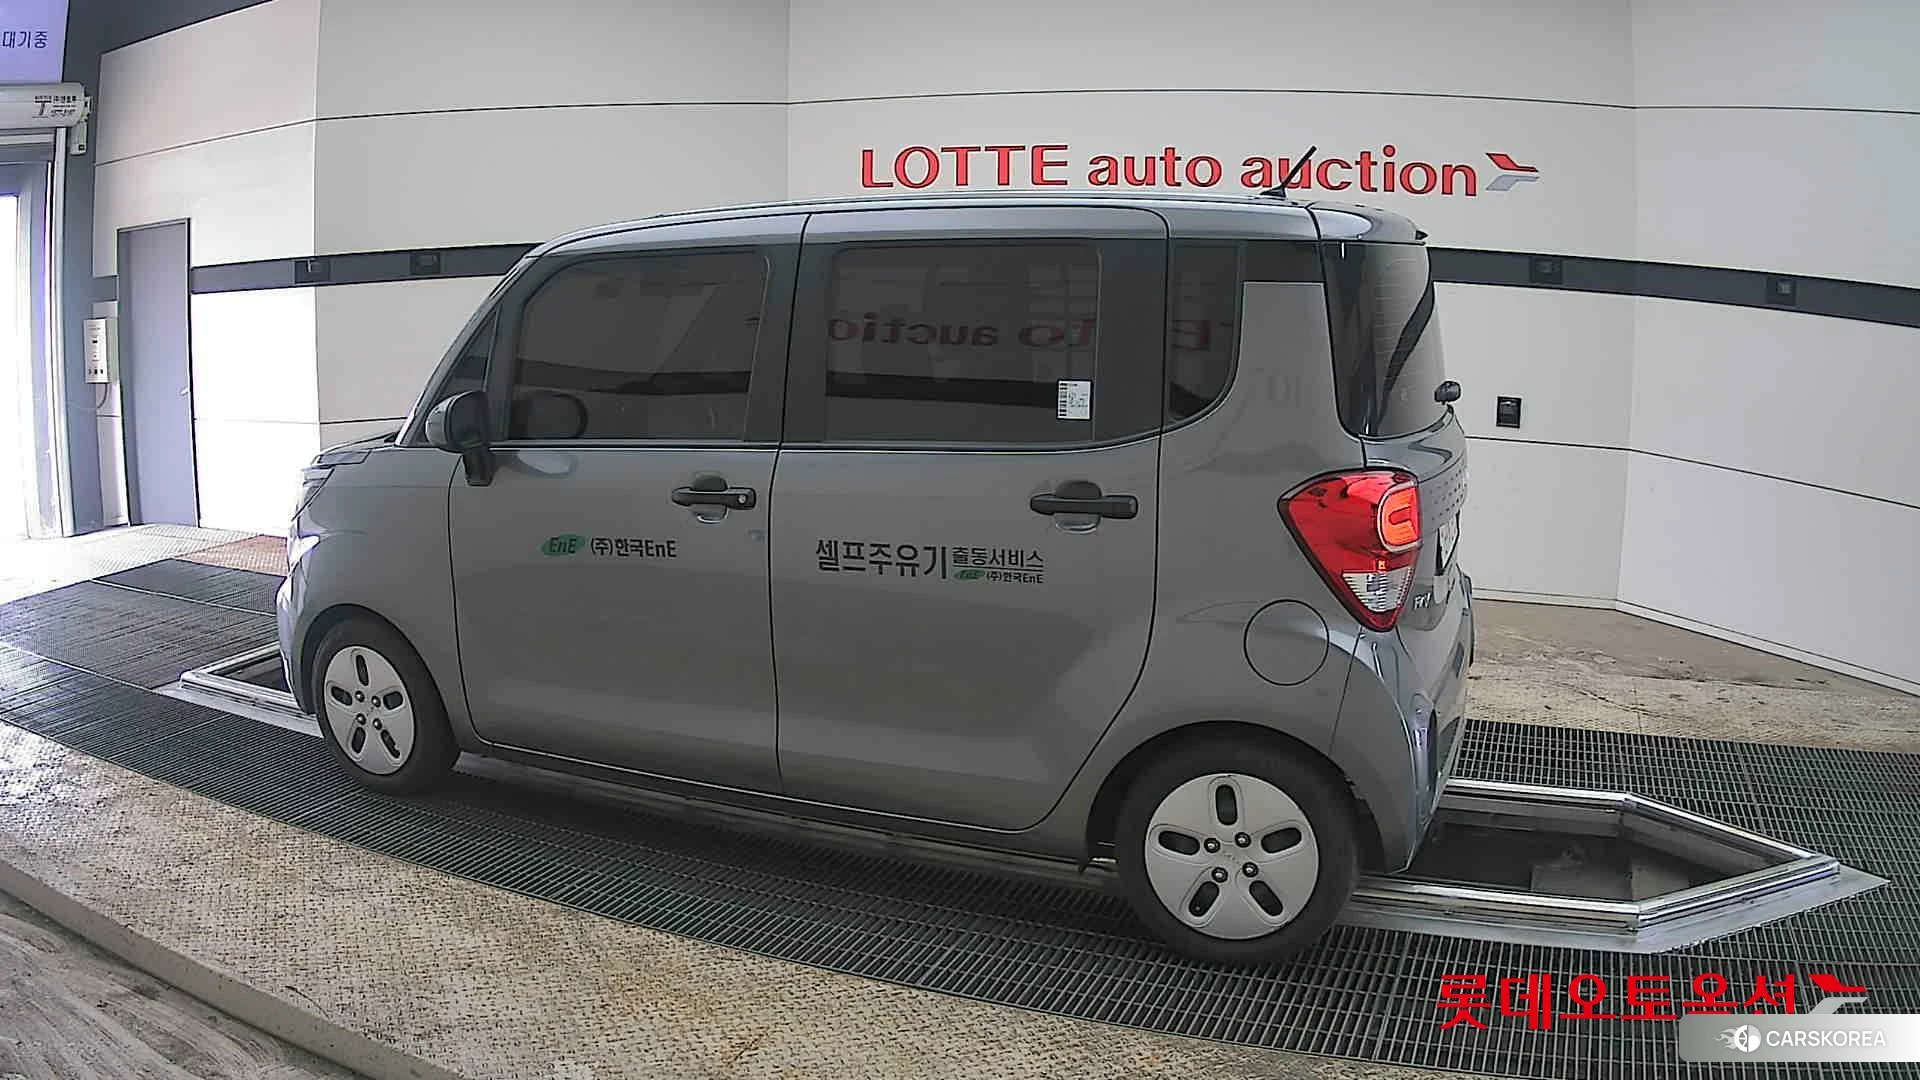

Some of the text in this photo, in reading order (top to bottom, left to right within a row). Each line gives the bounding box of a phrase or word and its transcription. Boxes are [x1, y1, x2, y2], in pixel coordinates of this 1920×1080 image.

[2, 31, 48, 49] 대기중
[860, 143, 1478, 197] LOTTE auto auction
[815, 539, 947, 580] 셀프주유기
[951, 546, 1044, 568] 출동서비스
